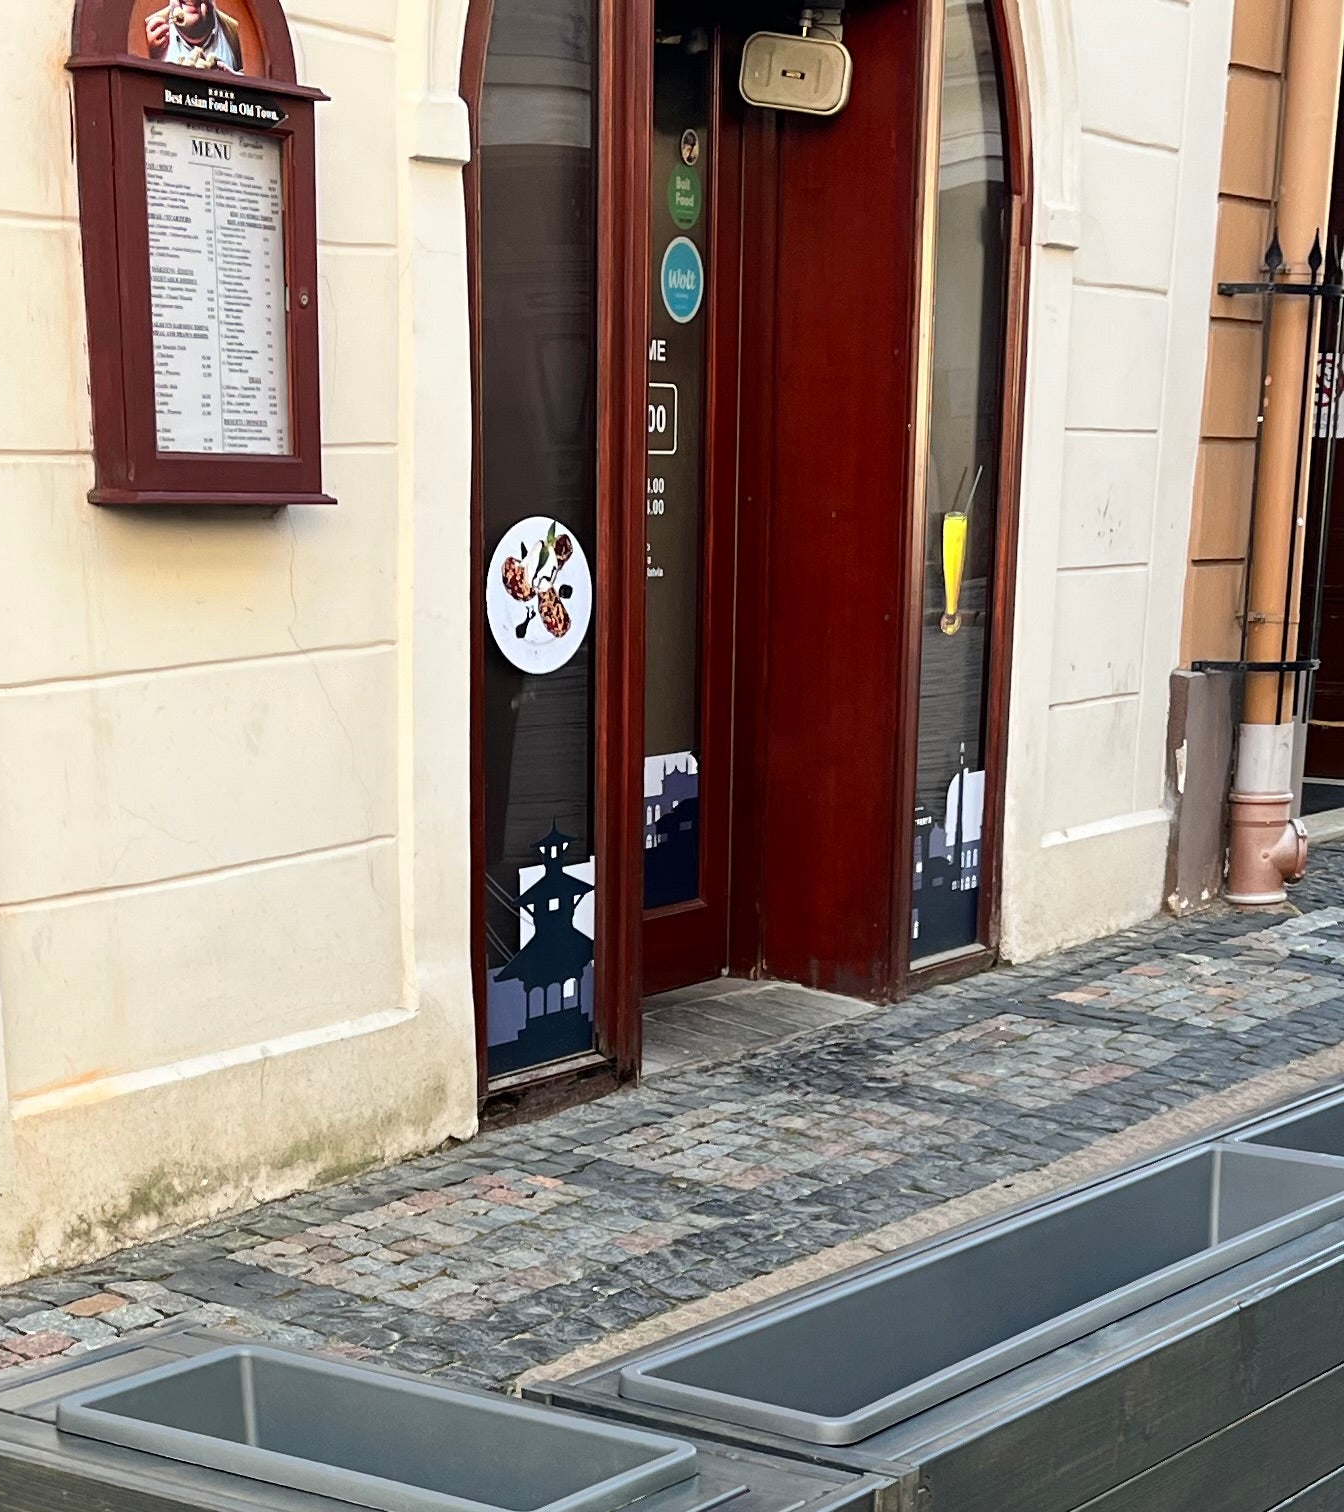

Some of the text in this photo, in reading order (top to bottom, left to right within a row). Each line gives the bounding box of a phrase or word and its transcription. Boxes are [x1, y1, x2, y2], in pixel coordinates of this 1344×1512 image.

[164, 89, 183, 105] Best
[184, 94, 208, 109] Asian
[208, 97, 229, 113] Food
[229, 100, 238, 114] in
[238, 102, 254, 117] Old
[191, 139, 232, 161] MENU
[676, 175, 691, 191] Bolt
[675, 191, 695, 207] Food
[668, 268, 696, 290] Wolt
